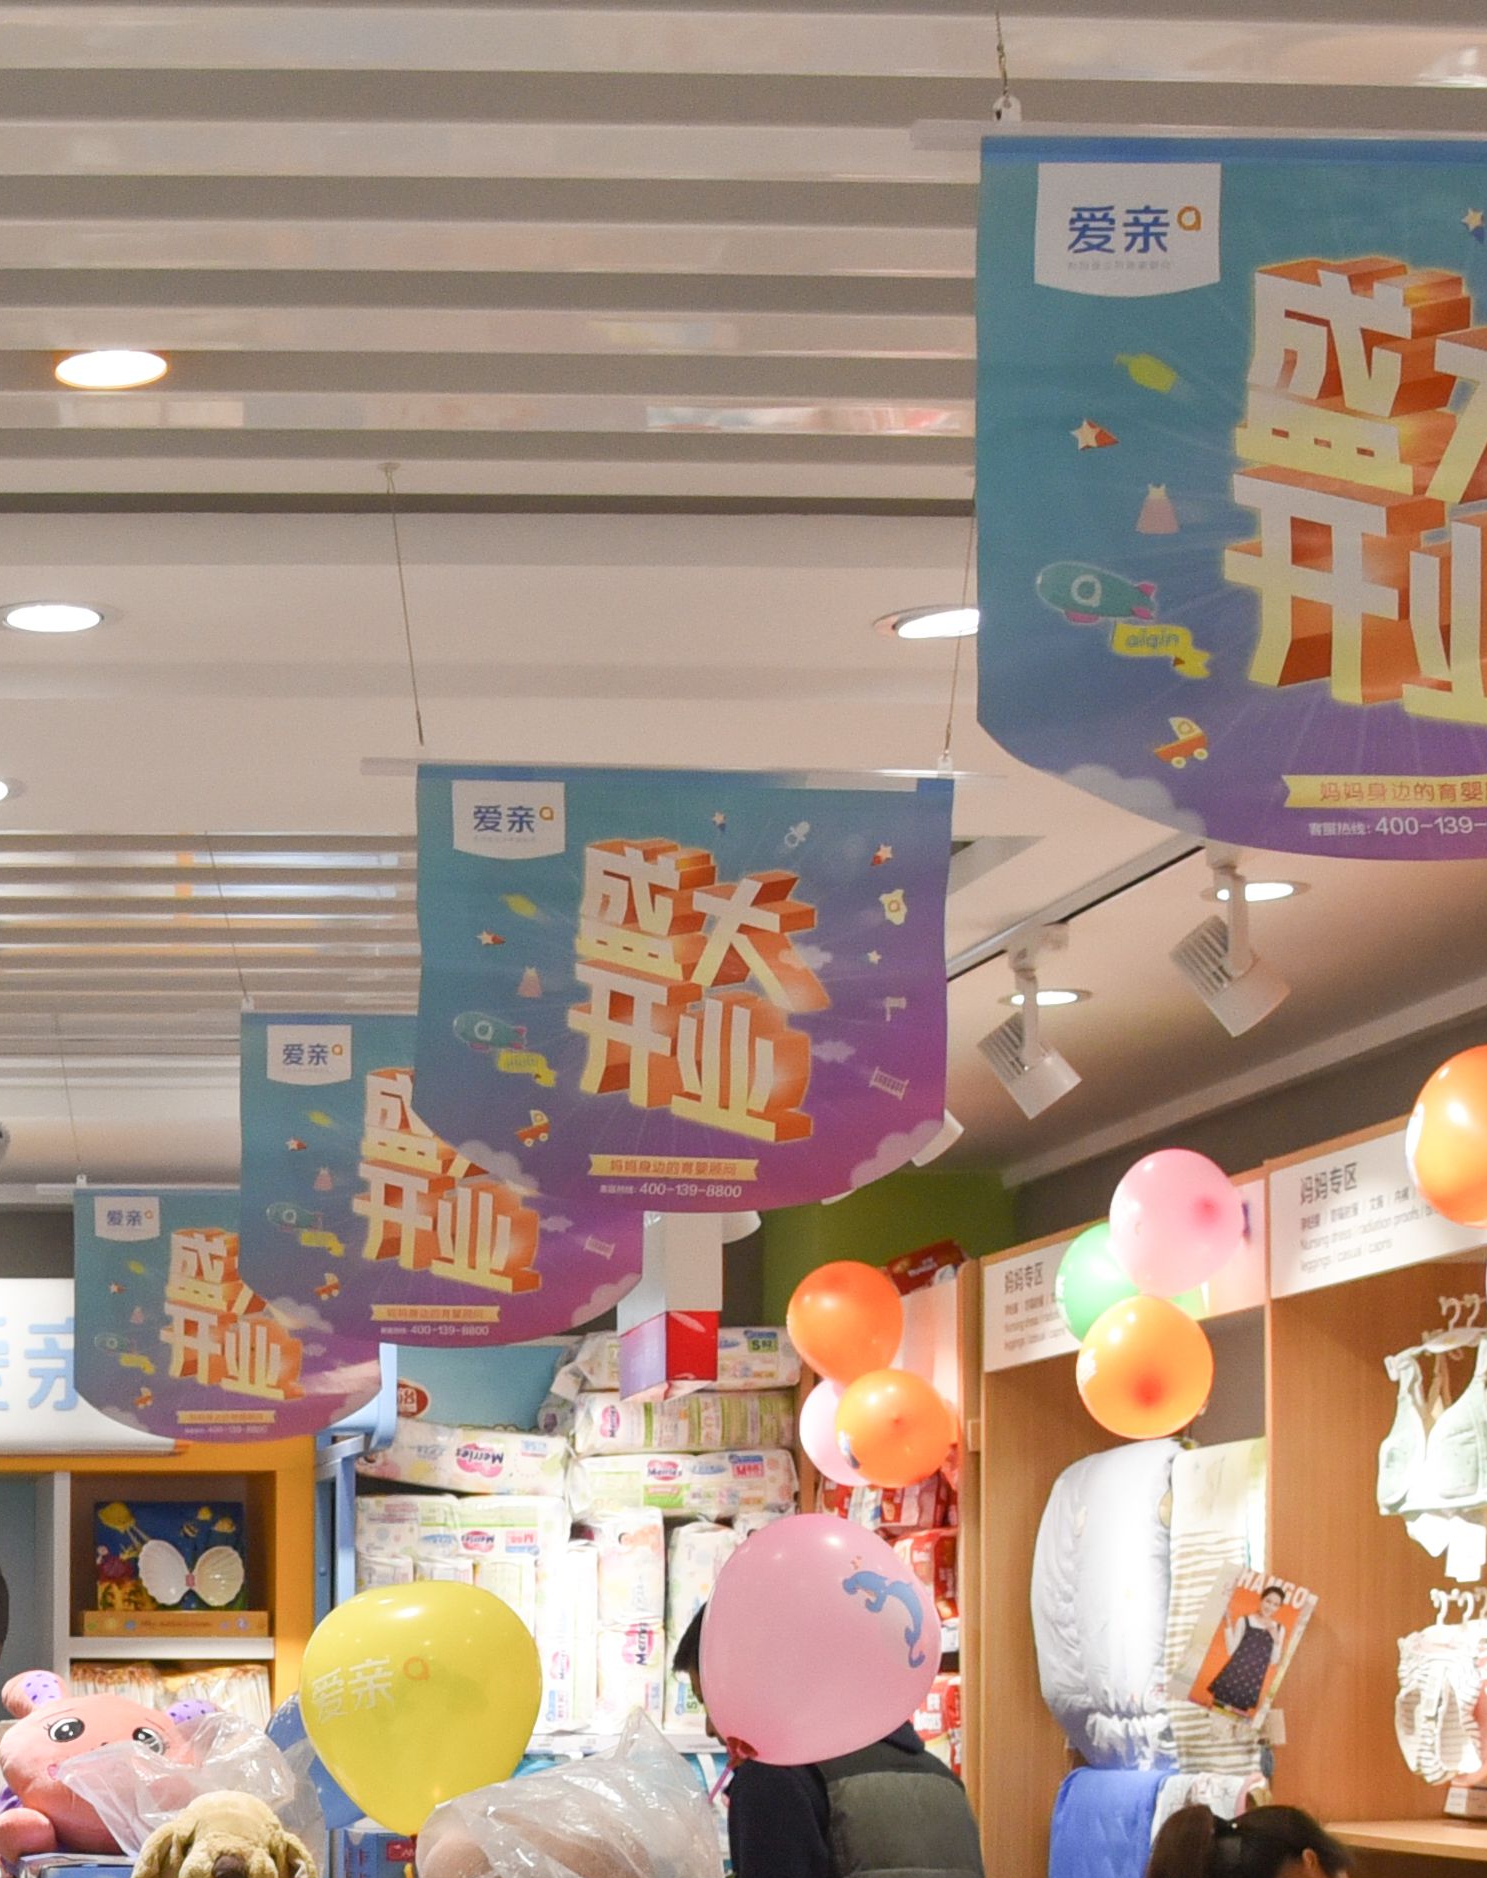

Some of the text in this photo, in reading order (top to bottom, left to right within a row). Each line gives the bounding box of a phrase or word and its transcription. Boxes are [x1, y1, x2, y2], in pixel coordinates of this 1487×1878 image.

[1068, 206, 1170, 254] 爱亲
[473, 804, 536, 834] 爱亲
[577, 839, 829, 1012] 盛大
[282, 1043, 329, 1066] 爱亲
[568, 961, 812, 1144] 开业
[638, 1183, 742, 1199] 400-139-8800
[1299, 1162, 1359, 1207] 妈妈专区
[354, 1160, 544, 1296] 开业
[1004, 1261, 1044, 1294] 妈妈专区
[163, 1303, 305, 1403] 开业
[457, 1446, 505, 1465] Merries
[309, 1655, 396, 1723] 爱亲
